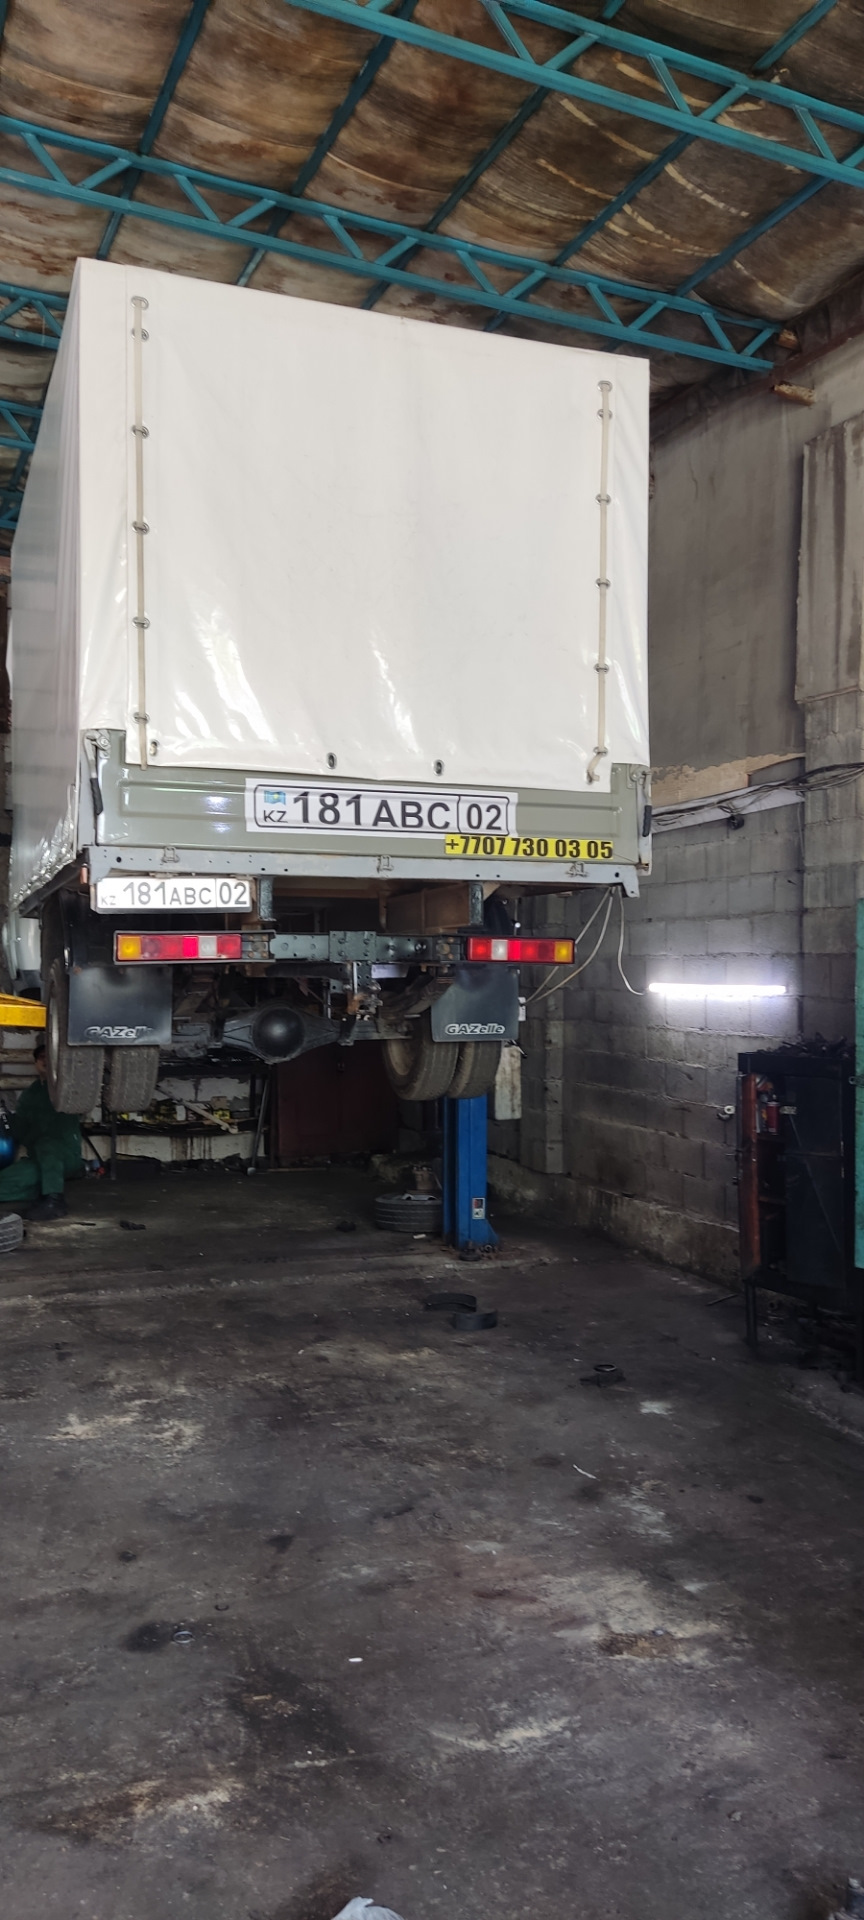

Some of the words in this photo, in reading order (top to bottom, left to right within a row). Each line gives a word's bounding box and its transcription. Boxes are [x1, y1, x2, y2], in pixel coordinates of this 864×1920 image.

[263, 810, 288, 823] KZ
[467, 803, 502, 830] 02
[446, 836, 506, 855] +7707
[511, 838, 548, 857] 730
[555, 839, 581, 858] 03
[587, 841, 613, 859] 05
[101, 895, 116, 906] KZ
[219, 882, 248, 905] 02
[445, 1023, 506, 1035] GAZelle
